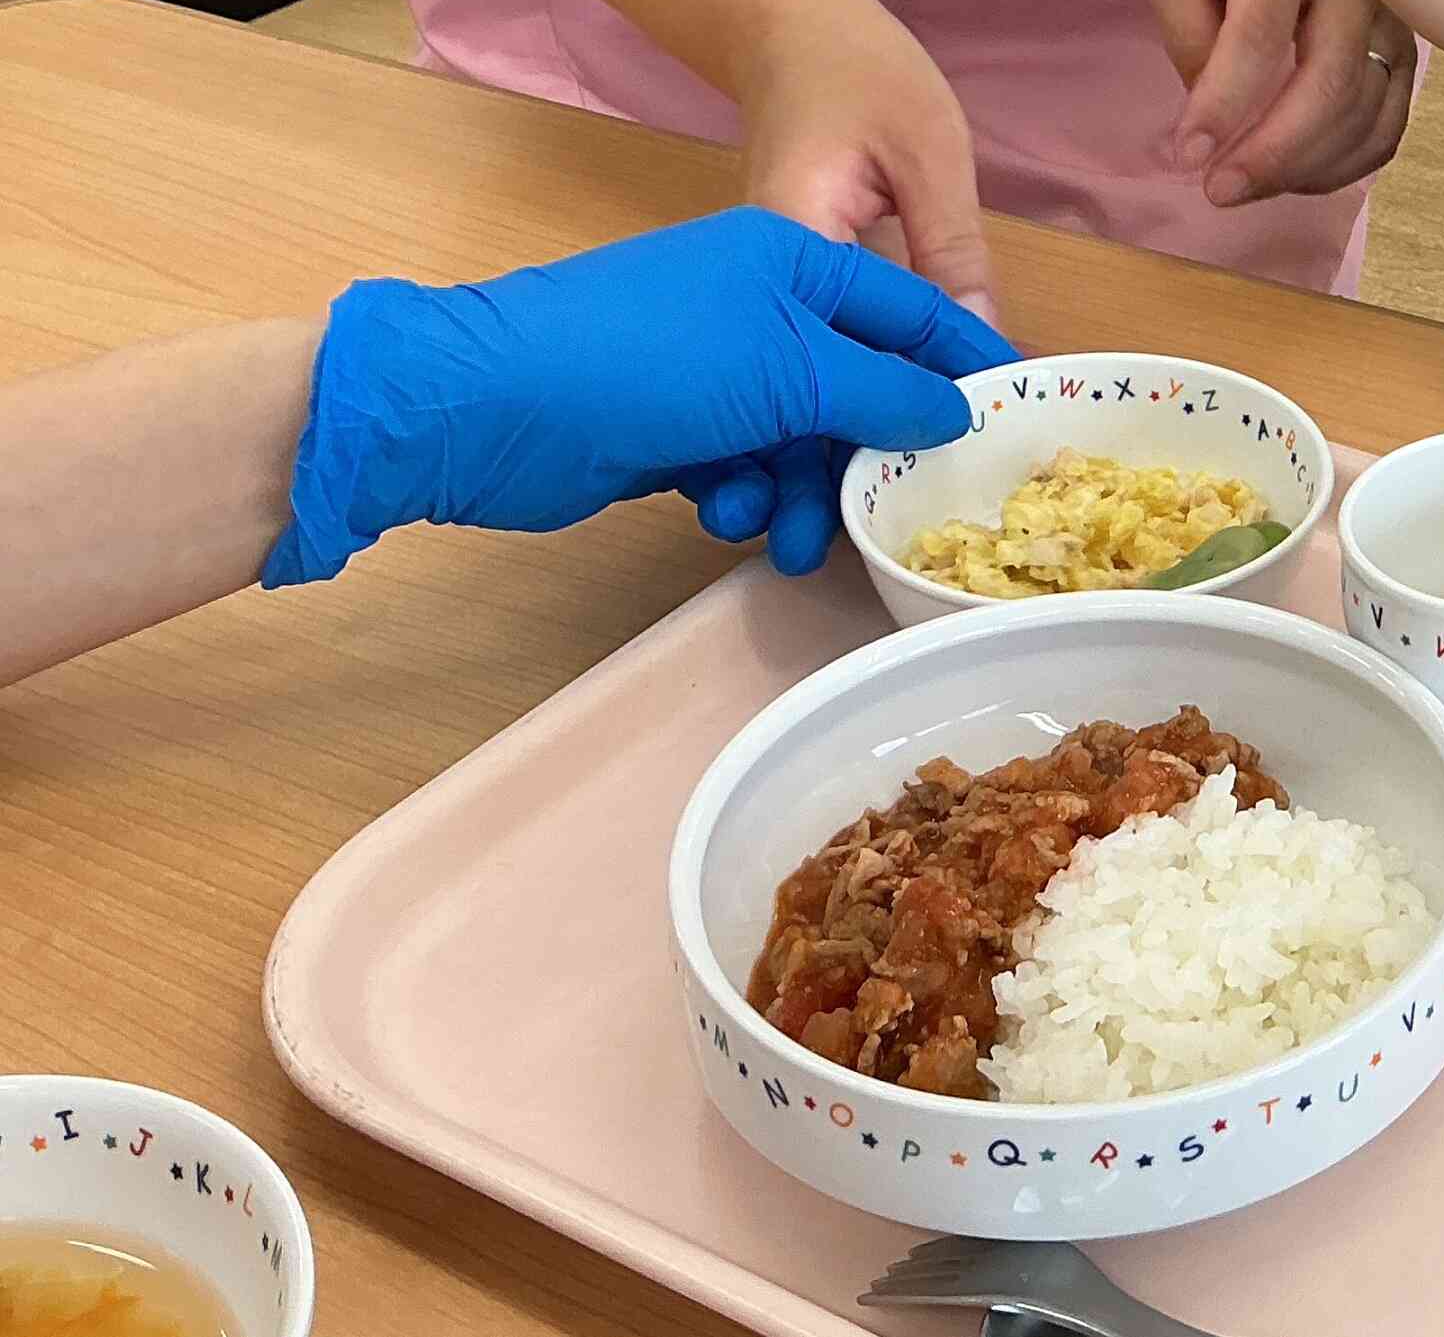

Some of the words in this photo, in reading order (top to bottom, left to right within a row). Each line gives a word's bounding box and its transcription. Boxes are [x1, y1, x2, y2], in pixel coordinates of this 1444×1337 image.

[864, 491, 876, 514] Q
[882, 463, 890, 483] R
[901, 451, 916, 469] S
[970, 409, 984, 432] U
[1013, 377, 1027, 399] V
[1060, 376, 1084, 398] W
[1114, 378, 1135, 400] X
[1169, 379, 1183, 398] Y
[1202, 390, 1219, 411] Z
[1258, 419, 1269, 440] A
[1285, 430, 1295, 450] B
[1297, 465, 1306, 482] C
[1371, 604, 1383, 629] V
[714, 1024, 729, 1056] M
[763, 1078, 789, 1108] N
[830, 1103, 853, 1127] O
[902, 1140, 920, 1162] P
[988, 1140, 1026, 1166] Q
[1090, 1142, 1117, 1169] R
[1179, 1136, 1204, 1162] S
[1259, 1098, 1280, 1124] T
[1339, 1074, 1358, 1102] U
[1403, 1002, 1415, 1032] V
[55, 1110, 79, 1140] I
[130, 1128, 153, 1156] J
[197, 1162, 213, 1195] K
